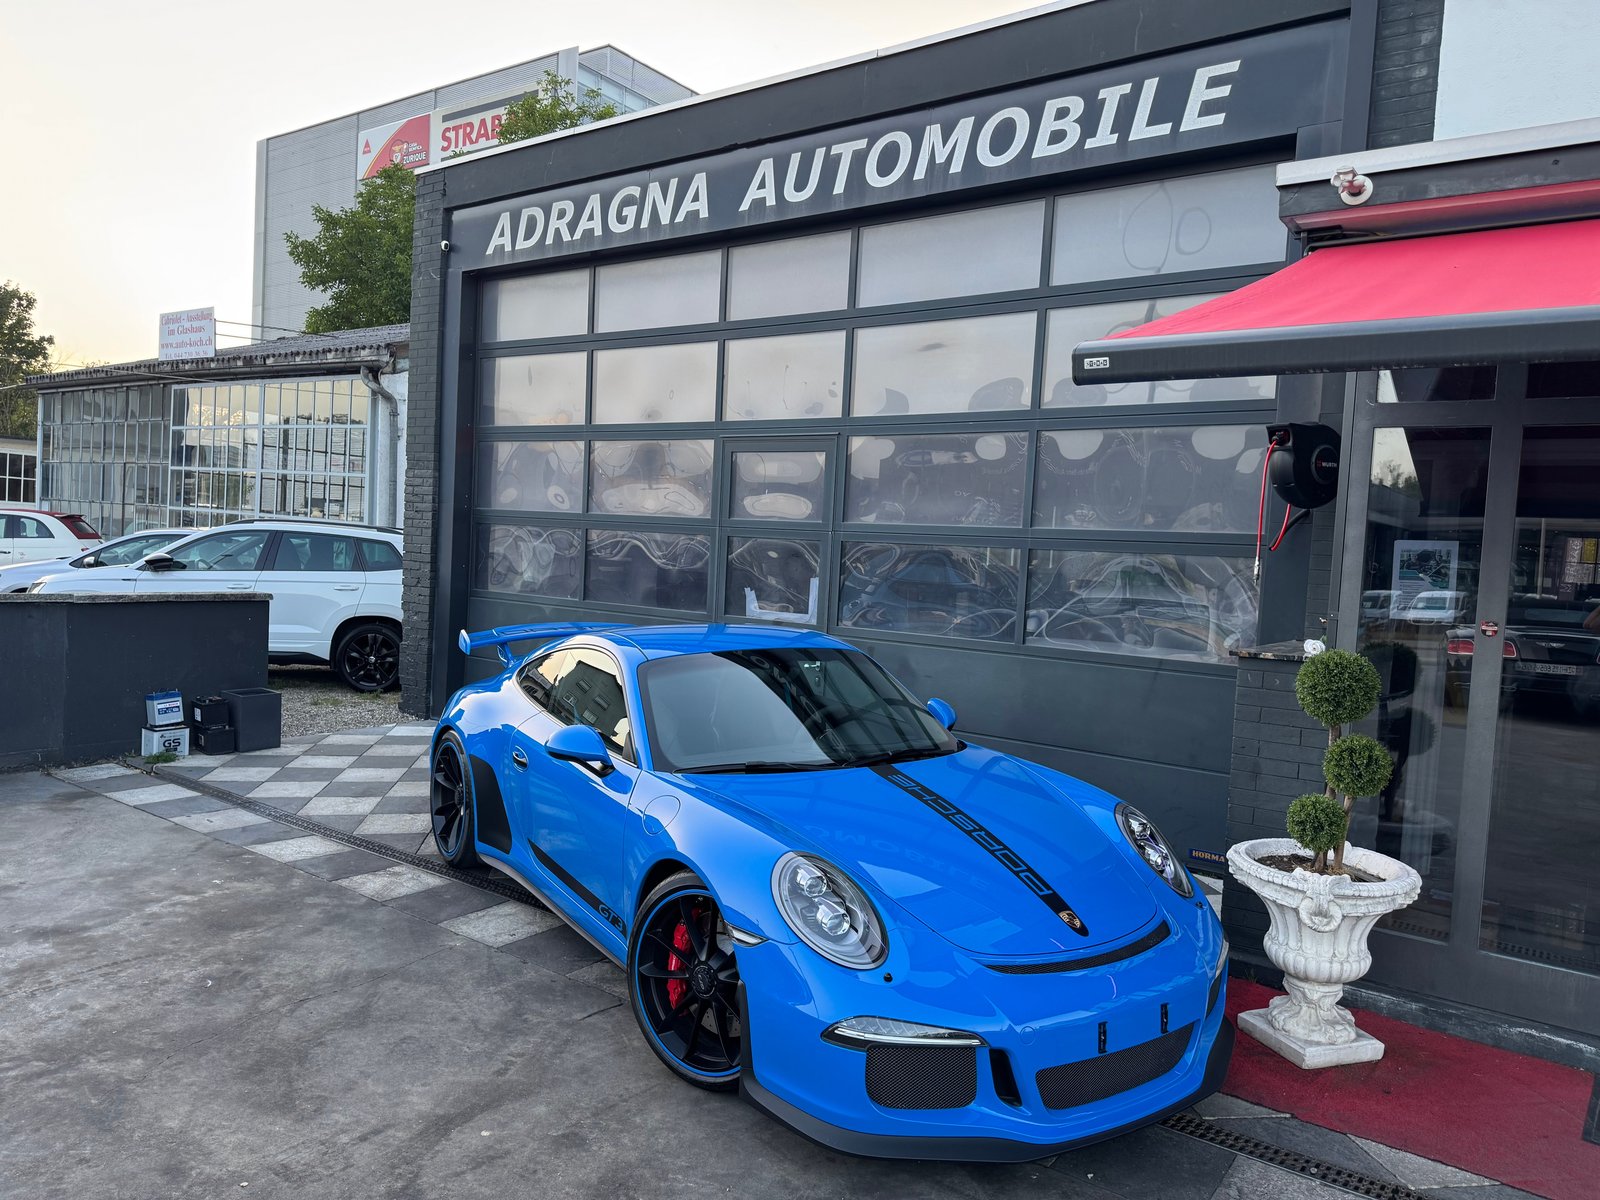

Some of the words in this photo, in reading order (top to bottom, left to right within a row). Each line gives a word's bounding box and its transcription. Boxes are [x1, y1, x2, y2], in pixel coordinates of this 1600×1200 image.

[403, 151, 427, 164] ZURIQUE
[486, 172, 709, 255] ADRAGNA
[738, 60, 1241, 211] AUTOMOBILE
[167, 326, 175, 336] im
[177, 324, 205, 335] Glashaus
[160, 336, 212, 349] www.auto-koch.ch
[162, 738, 180, 748] GS
[888, 774, 1053, 896] PORSCHE
[598, 904, 623, 931] GT3
